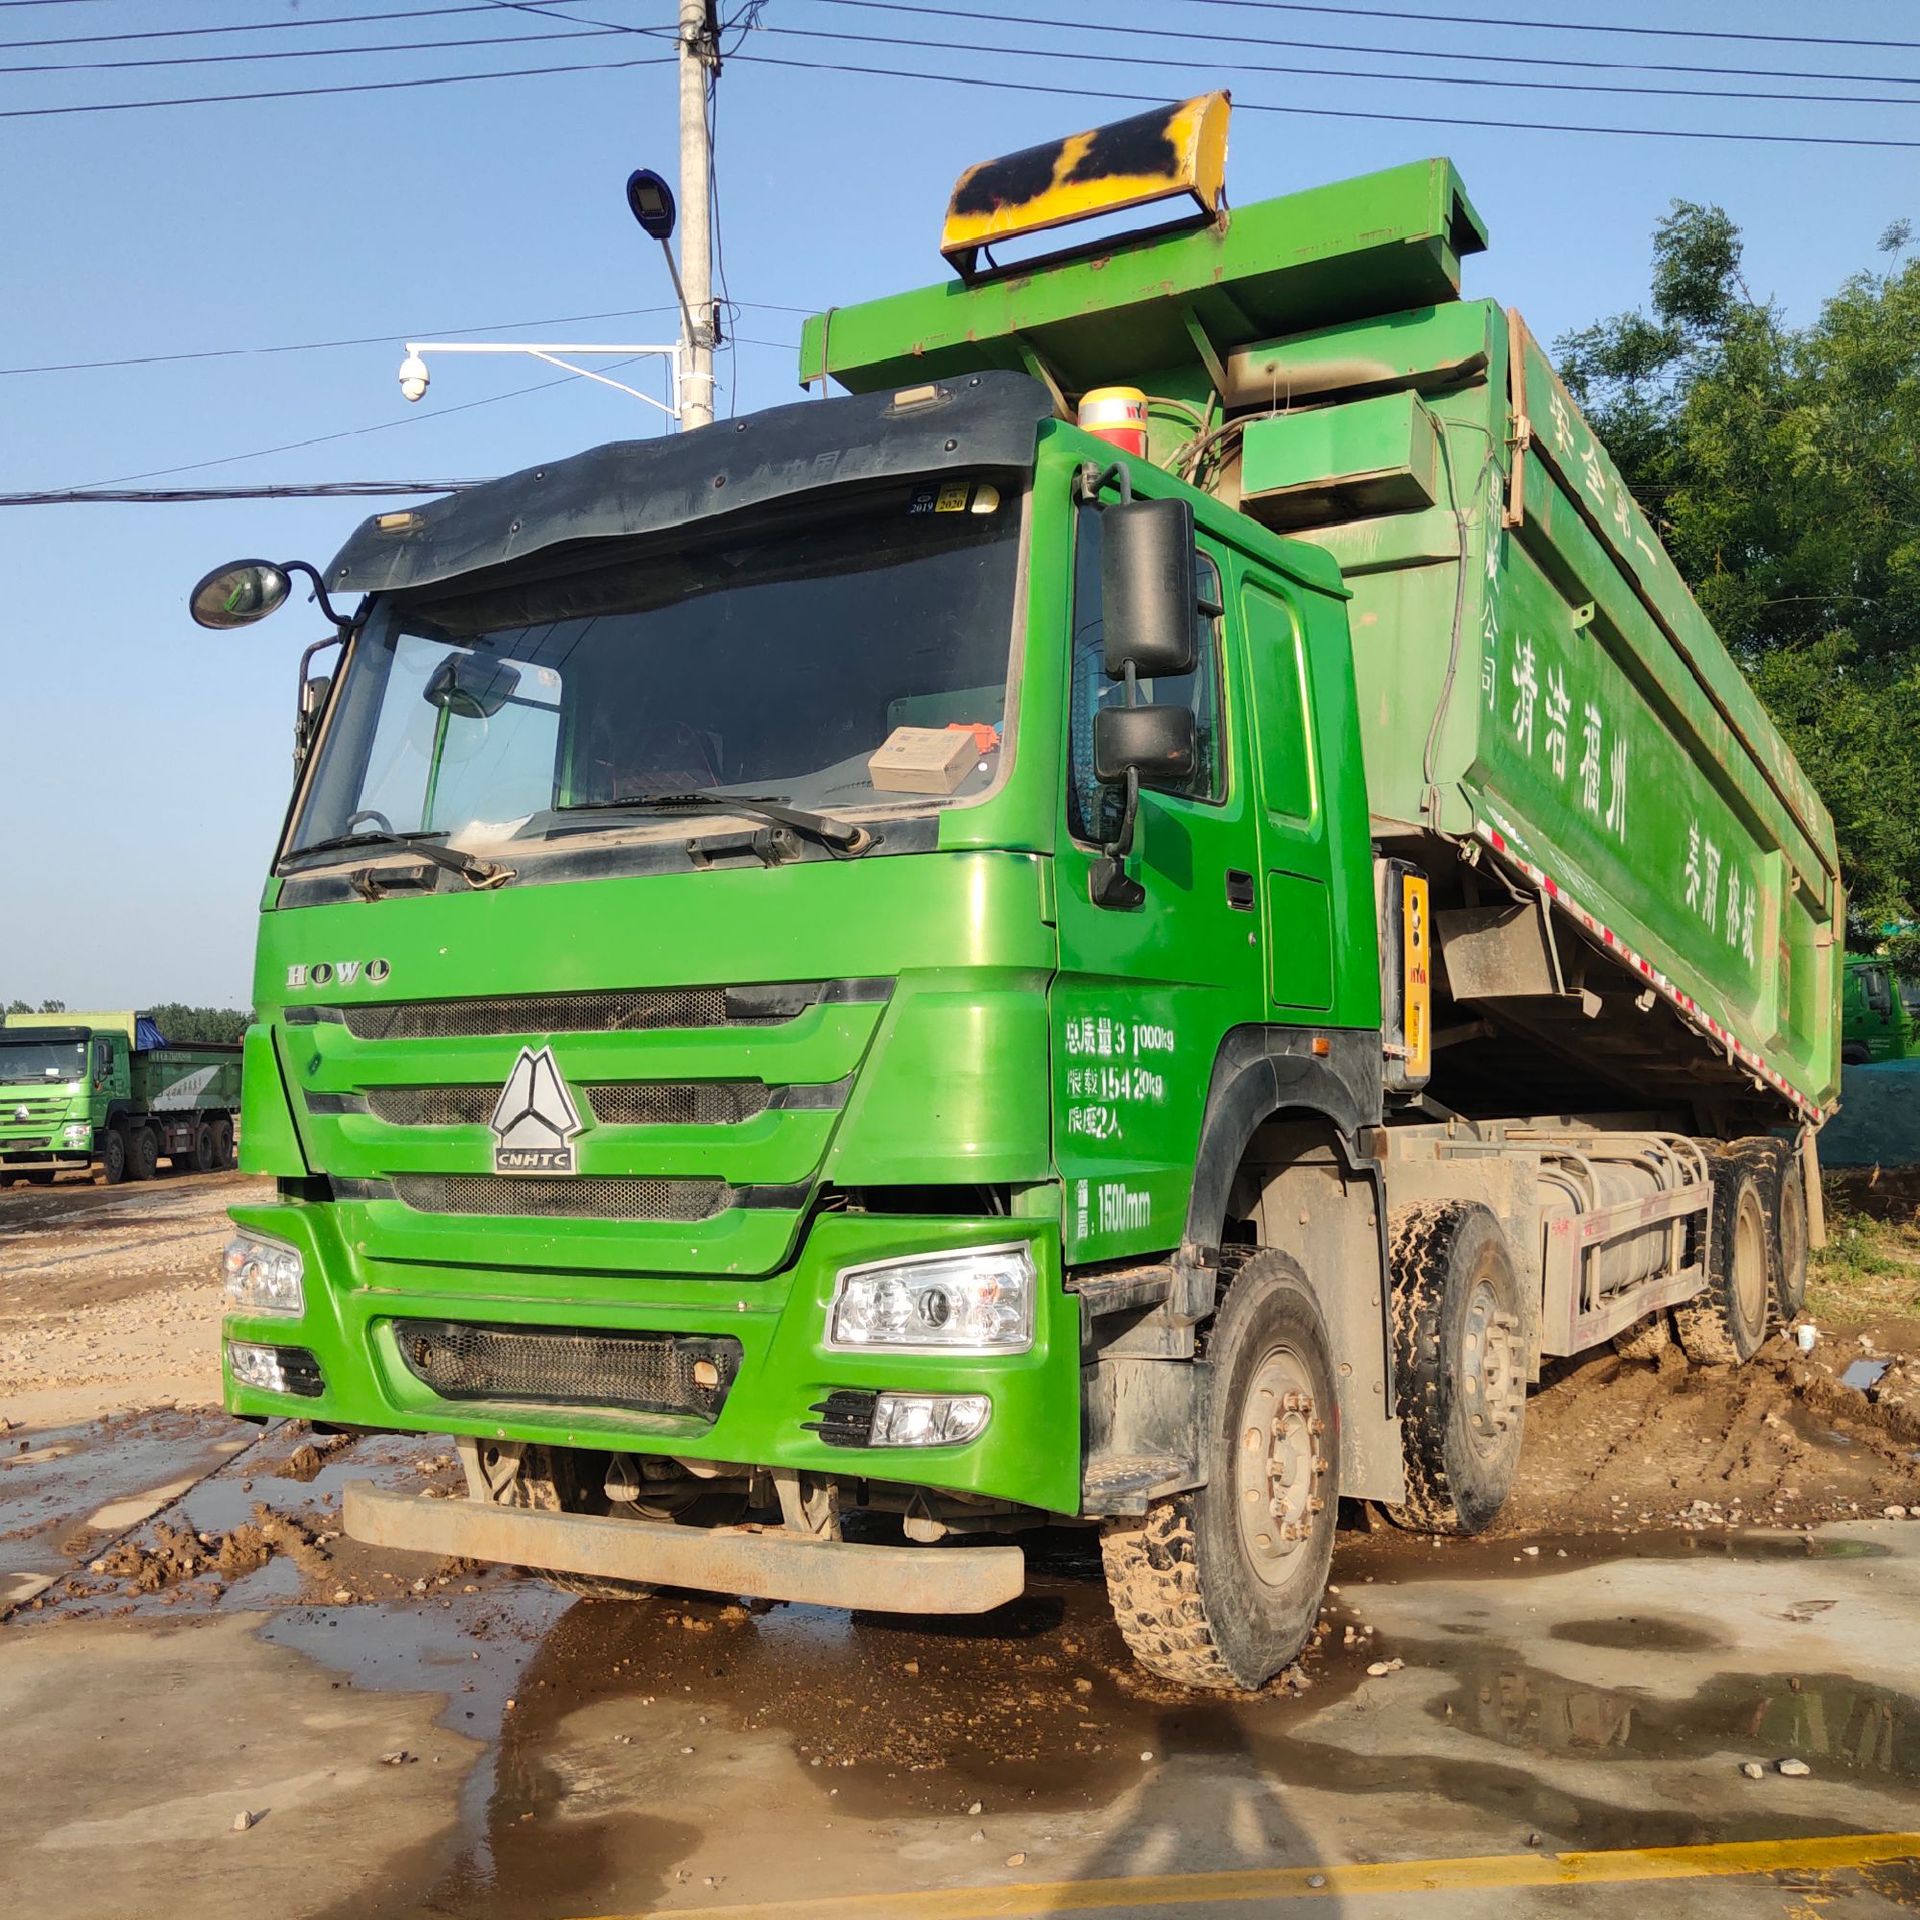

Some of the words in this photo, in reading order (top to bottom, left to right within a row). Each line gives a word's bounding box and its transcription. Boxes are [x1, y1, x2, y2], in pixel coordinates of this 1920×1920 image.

[910, 501, 933, 513] 2019
[940, 500, 963, 509] 2020
[1511, 632, 1627, 845] 清洁福州
[286, 959, 390, 987] HOWO
[498, 1153, 568, 1167] CNHTC
